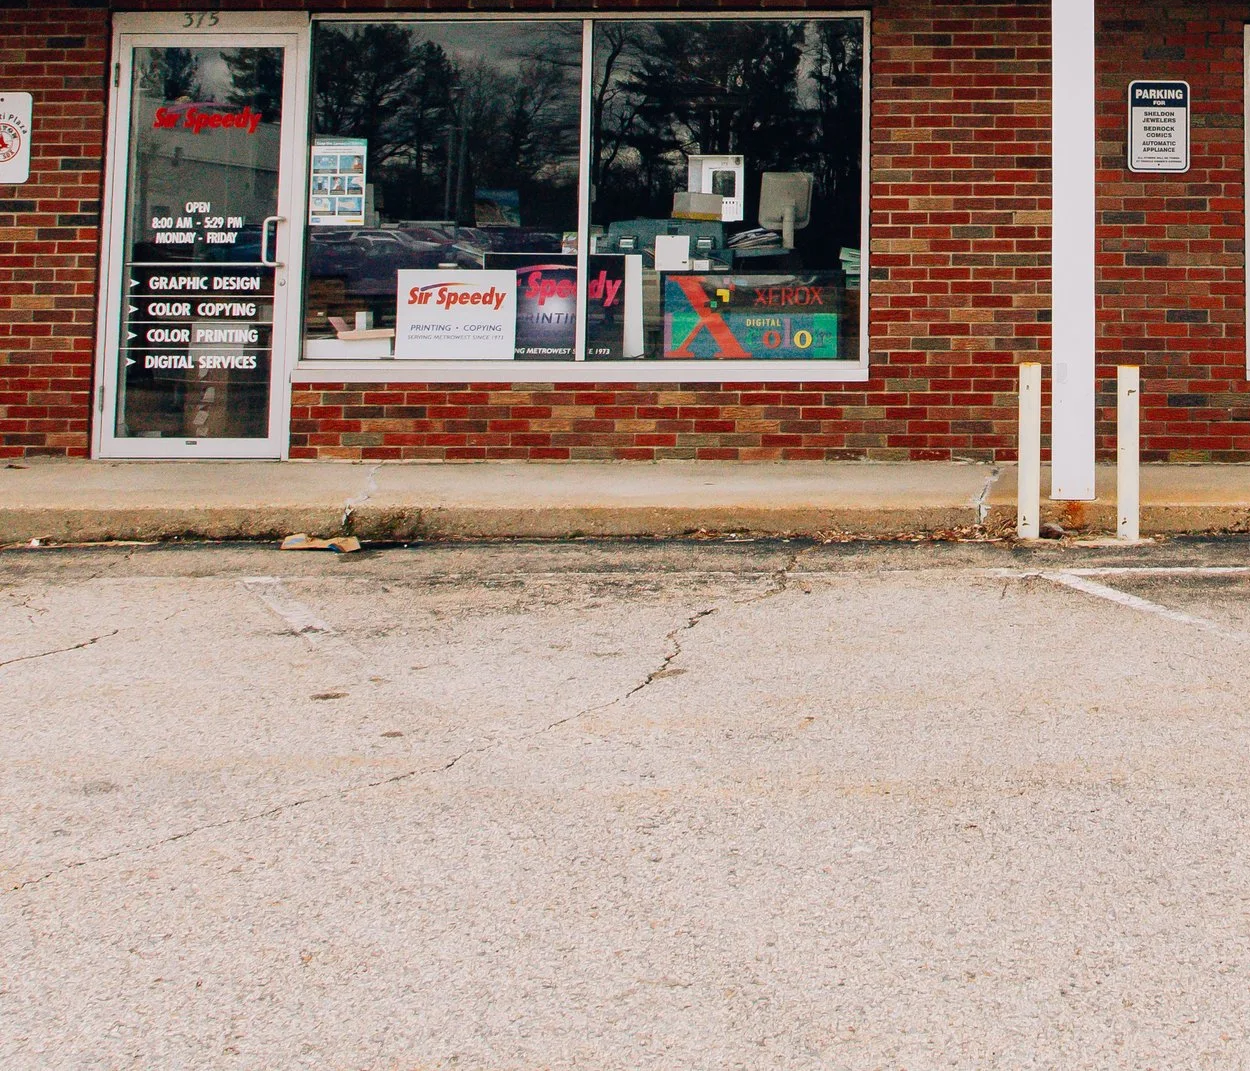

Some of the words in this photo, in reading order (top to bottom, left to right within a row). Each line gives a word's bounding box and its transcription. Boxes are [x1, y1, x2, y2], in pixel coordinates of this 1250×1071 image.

[183, 11, 219, 28] 375
[1135, 89, 1184, 99] PARKING
[8, 114, 28, 135] Plaza
[184, 105, 262, 135] Speedy
[185, 202, 211, 213] OPEN
[152, 217, 173, 228] 8:00
[176, 217, 193, 228] AM
[204, 217, 224, 228] 5:29
[227, 217, 243, 228] PM
[155, 232, 196, 244] MONDAY
[206, 232, 238, 244] FRIDAY
[149, 277, 208, 290] GRAPHIC
[213, 277, 261, 290] DESIGN
[525, 270, 622, 307] Spedy
[408, 287, 432, 305] Sir
[436, 286, 507, 310] Speedy
[754, 287, 824, 305] XEROX
[147, 303, 191, 316] COLOR
[197, 303, 256, 316] COPYING
[410, 324, 452, 332] PRINTING
[463, 324, 503, 332] COPYING
[746, 318, 781, 327] DIGITAL
[146, 329, 190, 343] COLOR
[196, 329, 259, 343] PRINTING
[526, 347, 571, 355] METROWEST
[144, 356, 194, 369] DIGITAL
[199, 355, 257, 369] SERVICES
